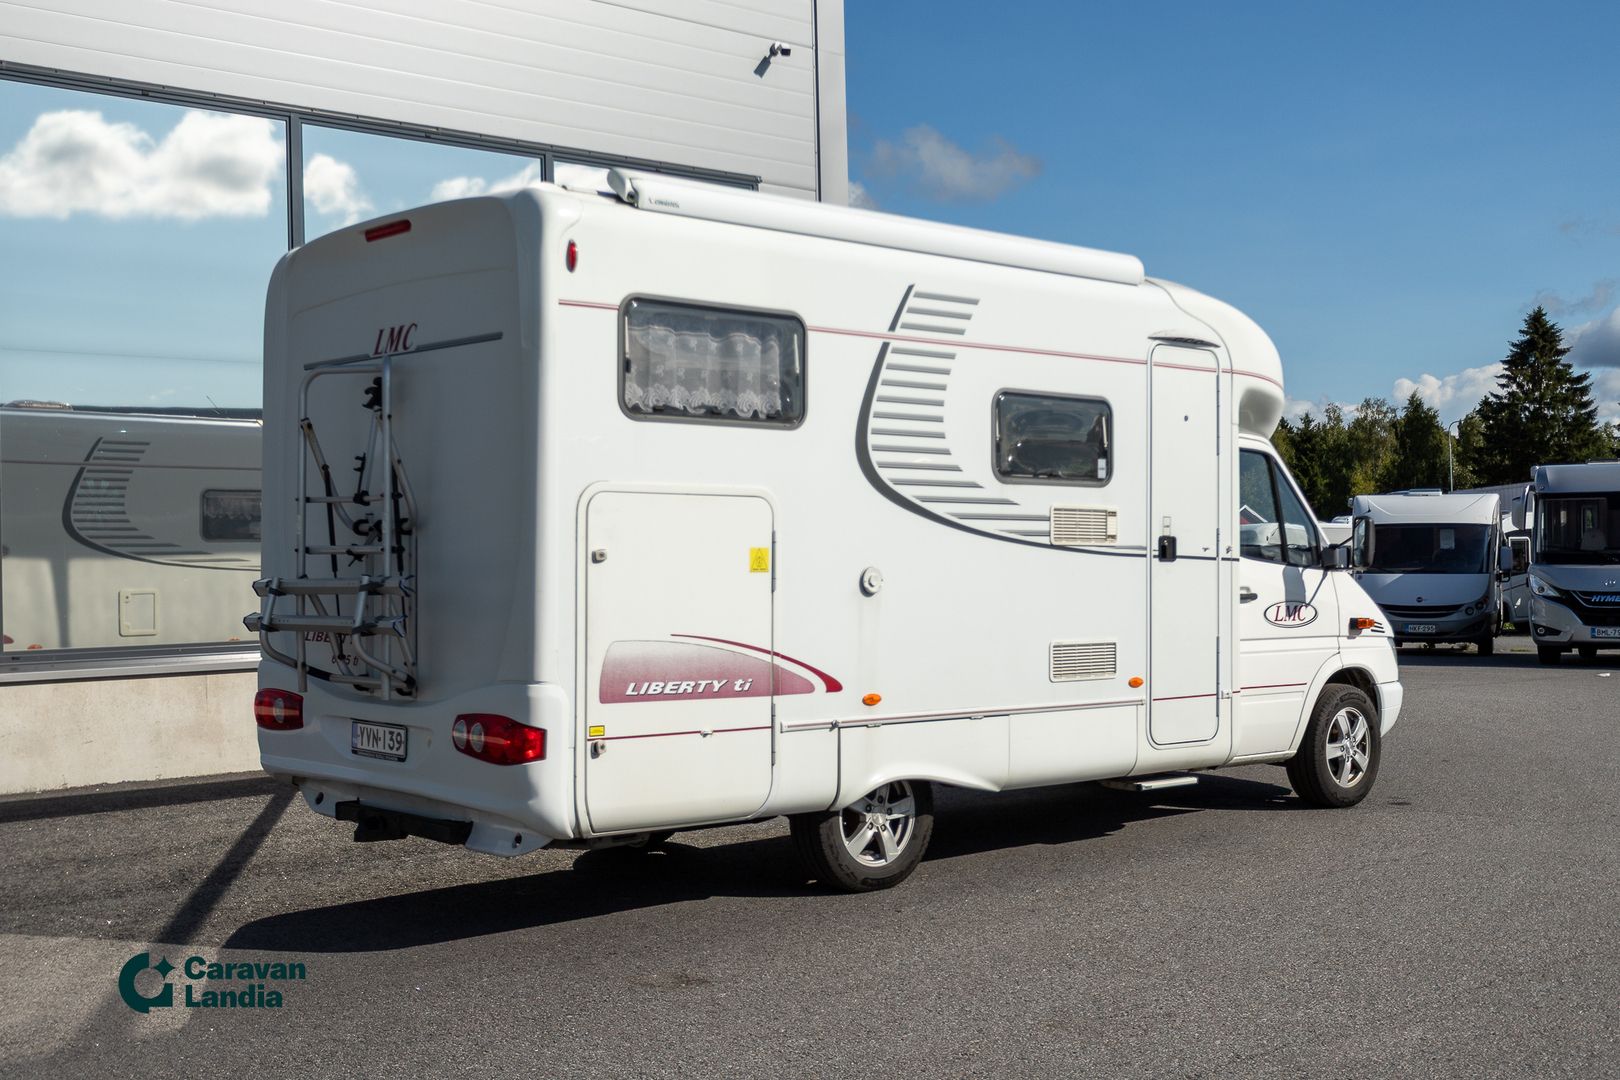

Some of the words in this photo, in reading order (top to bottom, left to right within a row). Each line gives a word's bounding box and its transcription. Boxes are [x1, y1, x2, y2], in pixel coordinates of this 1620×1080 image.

[373, 323, 418, 356] LMC
[1274, 605, 1309, 622] LMC
[625, 679, 728, 697] LIBERTY
[734, 678, 753, 693] ti
[359, 726, 403, 752] YVN-139
